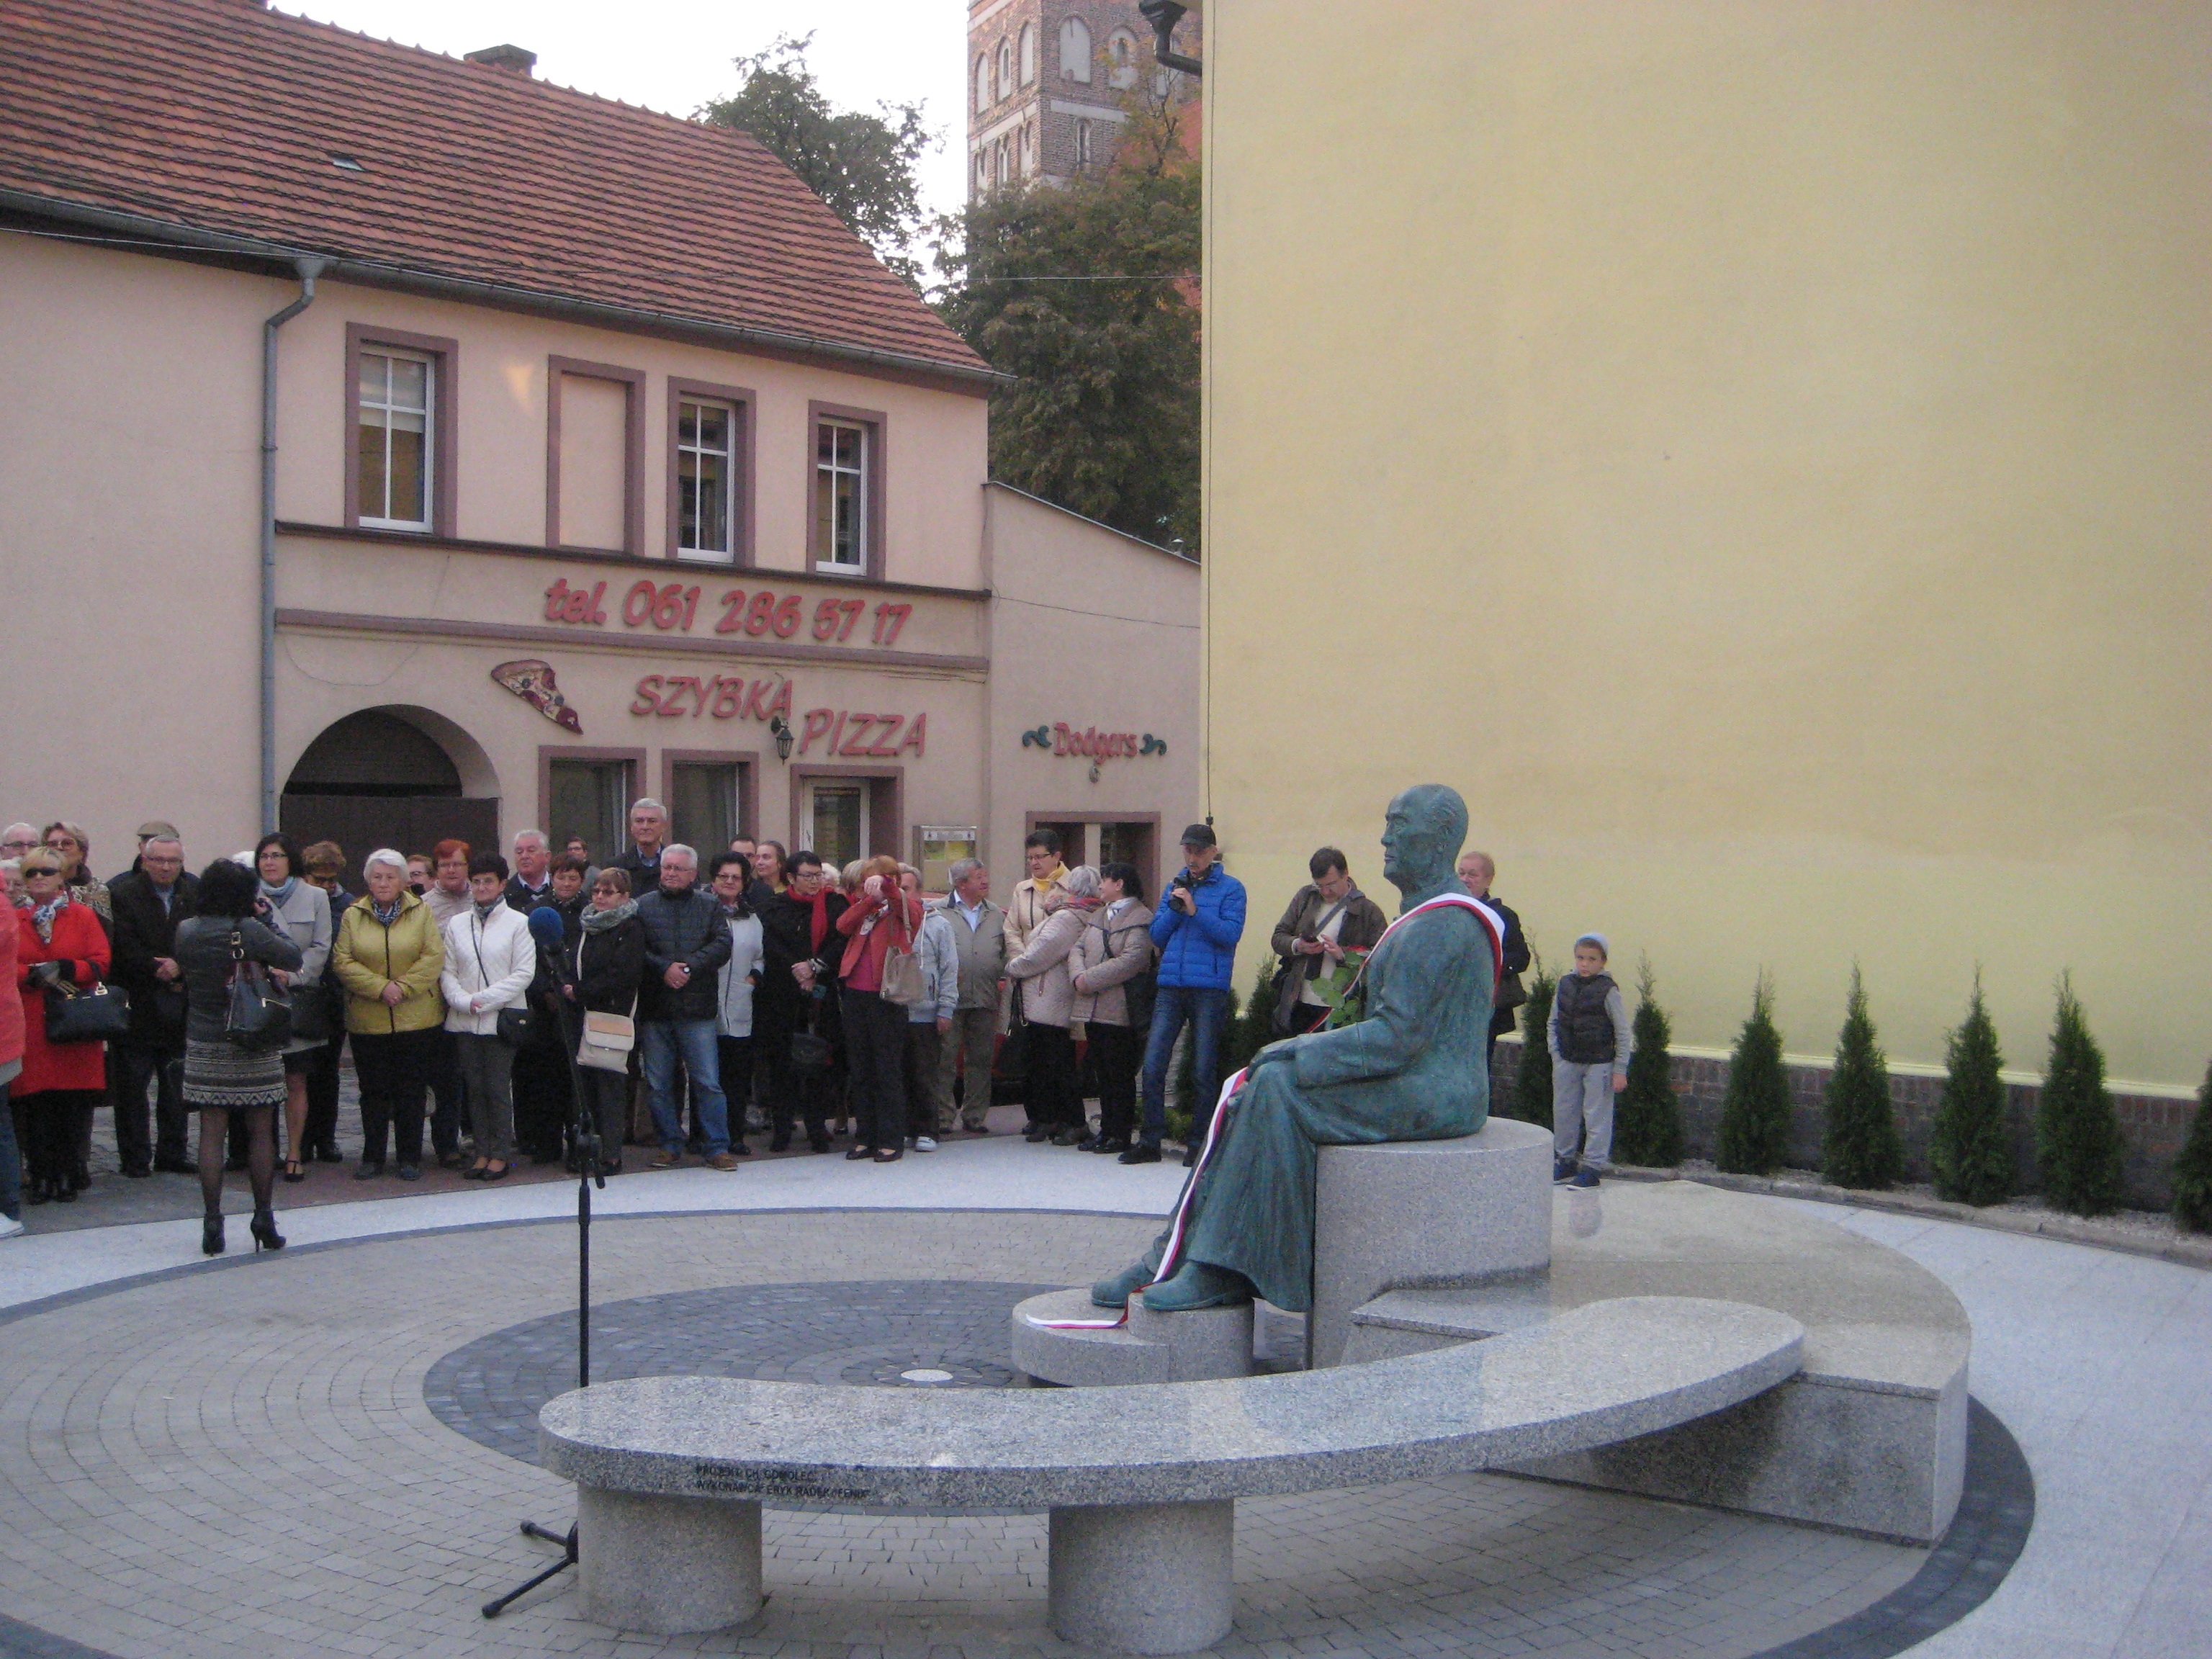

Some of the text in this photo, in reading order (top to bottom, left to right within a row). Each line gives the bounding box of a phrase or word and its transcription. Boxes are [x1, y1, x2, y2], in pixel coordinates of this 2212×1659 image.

[545, 578, 912, 645] tel. 061 286 57 17
[630, 674, 793, 721] SZYBKA
[798, 709, 927, 757] PIZZA
[1053, 721, 1139, 765] Dodgers
